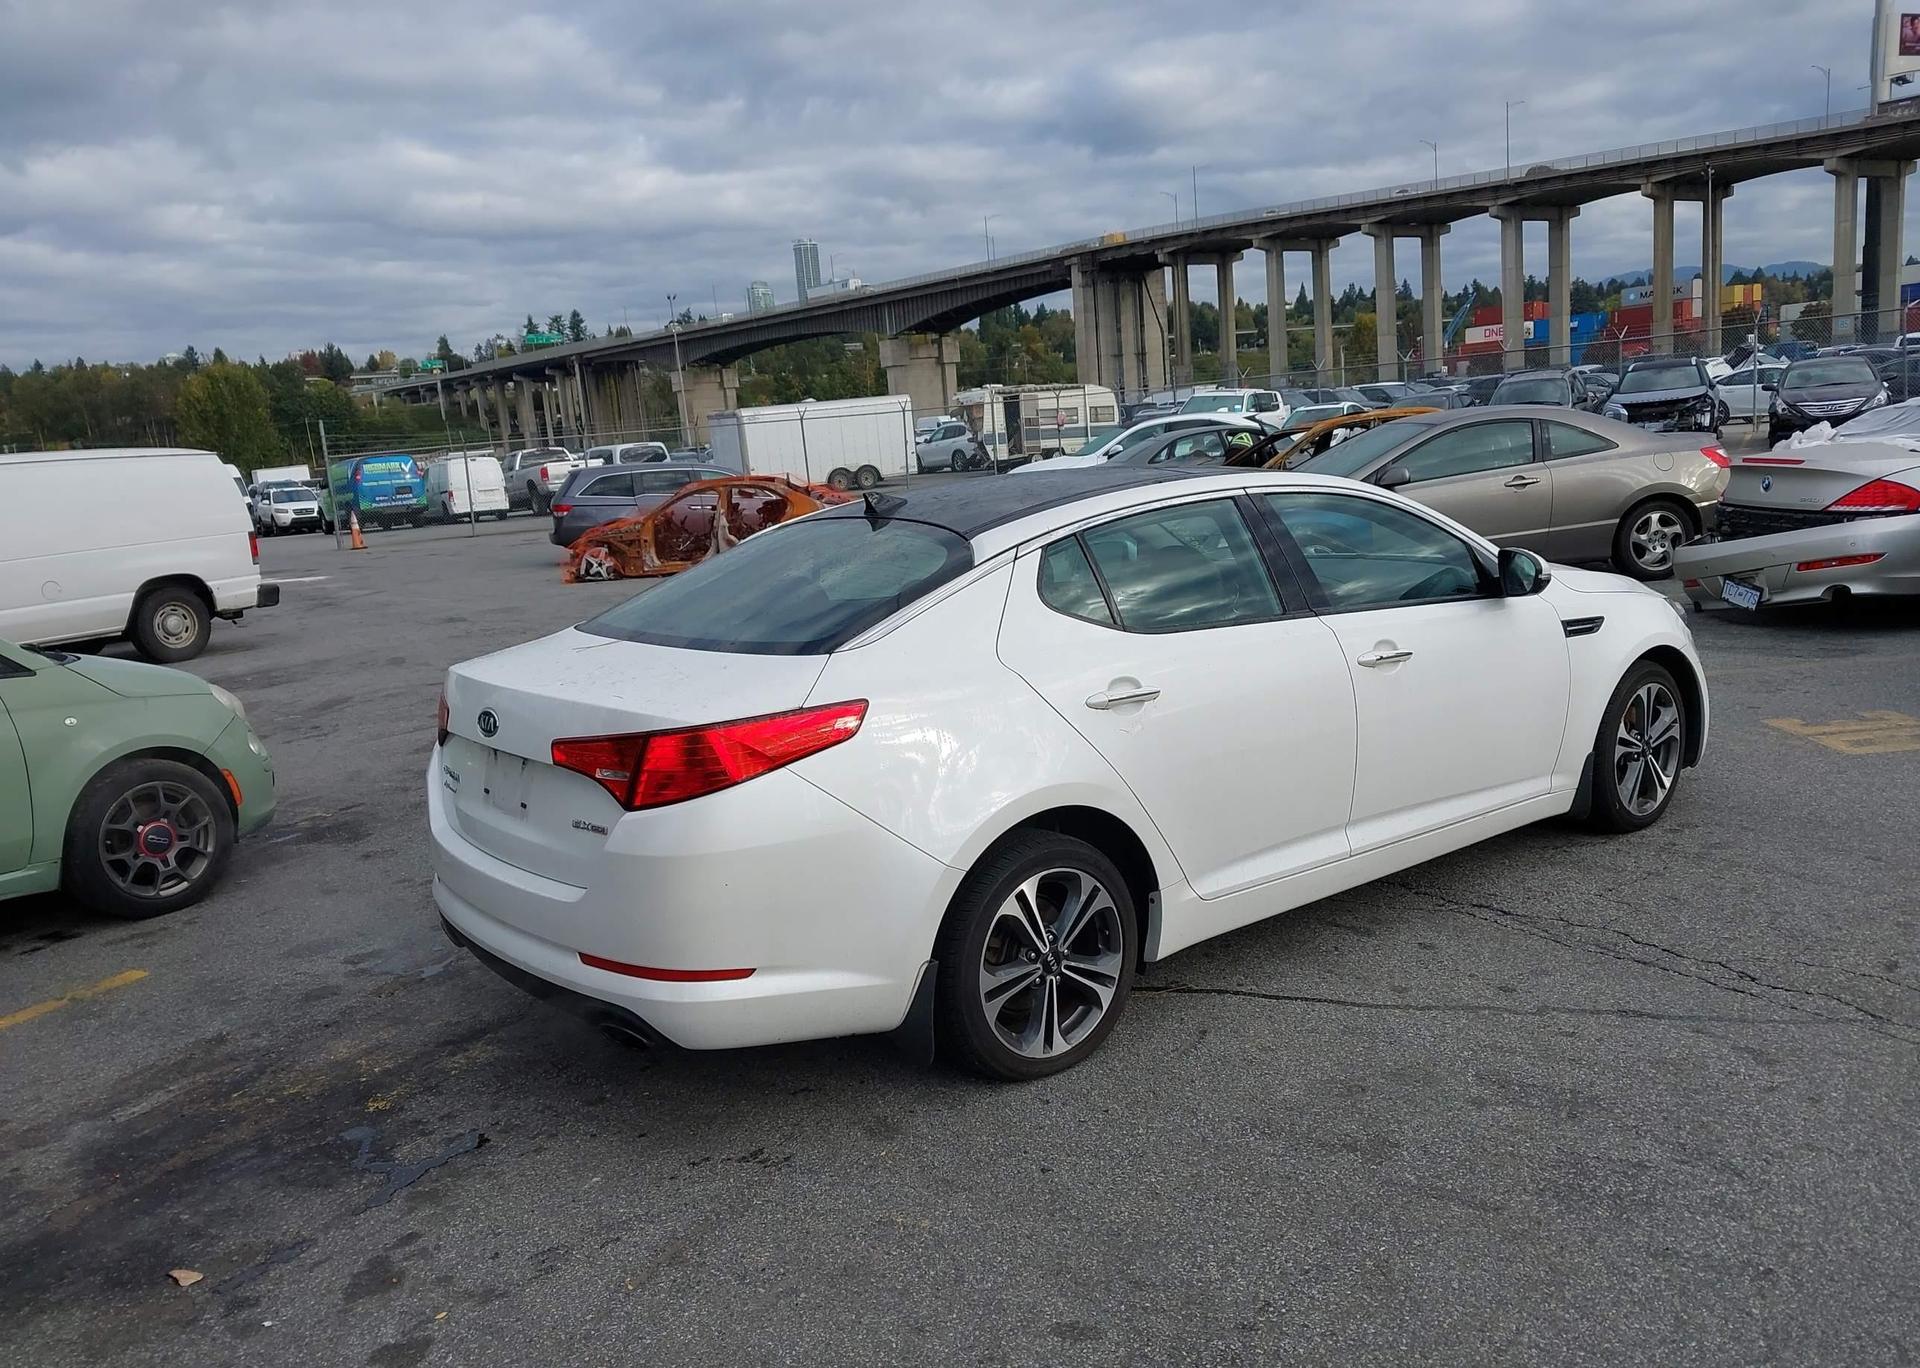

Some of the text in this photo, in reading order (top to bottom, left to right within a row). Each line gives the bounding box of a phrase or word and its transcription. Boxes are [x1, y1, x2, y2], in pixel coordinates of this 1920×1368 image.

[1639, 286, 1683, 299] MASK
[1484, 327, 1504, 338] ONE
[1046, 952, 1059, 972] KIA
